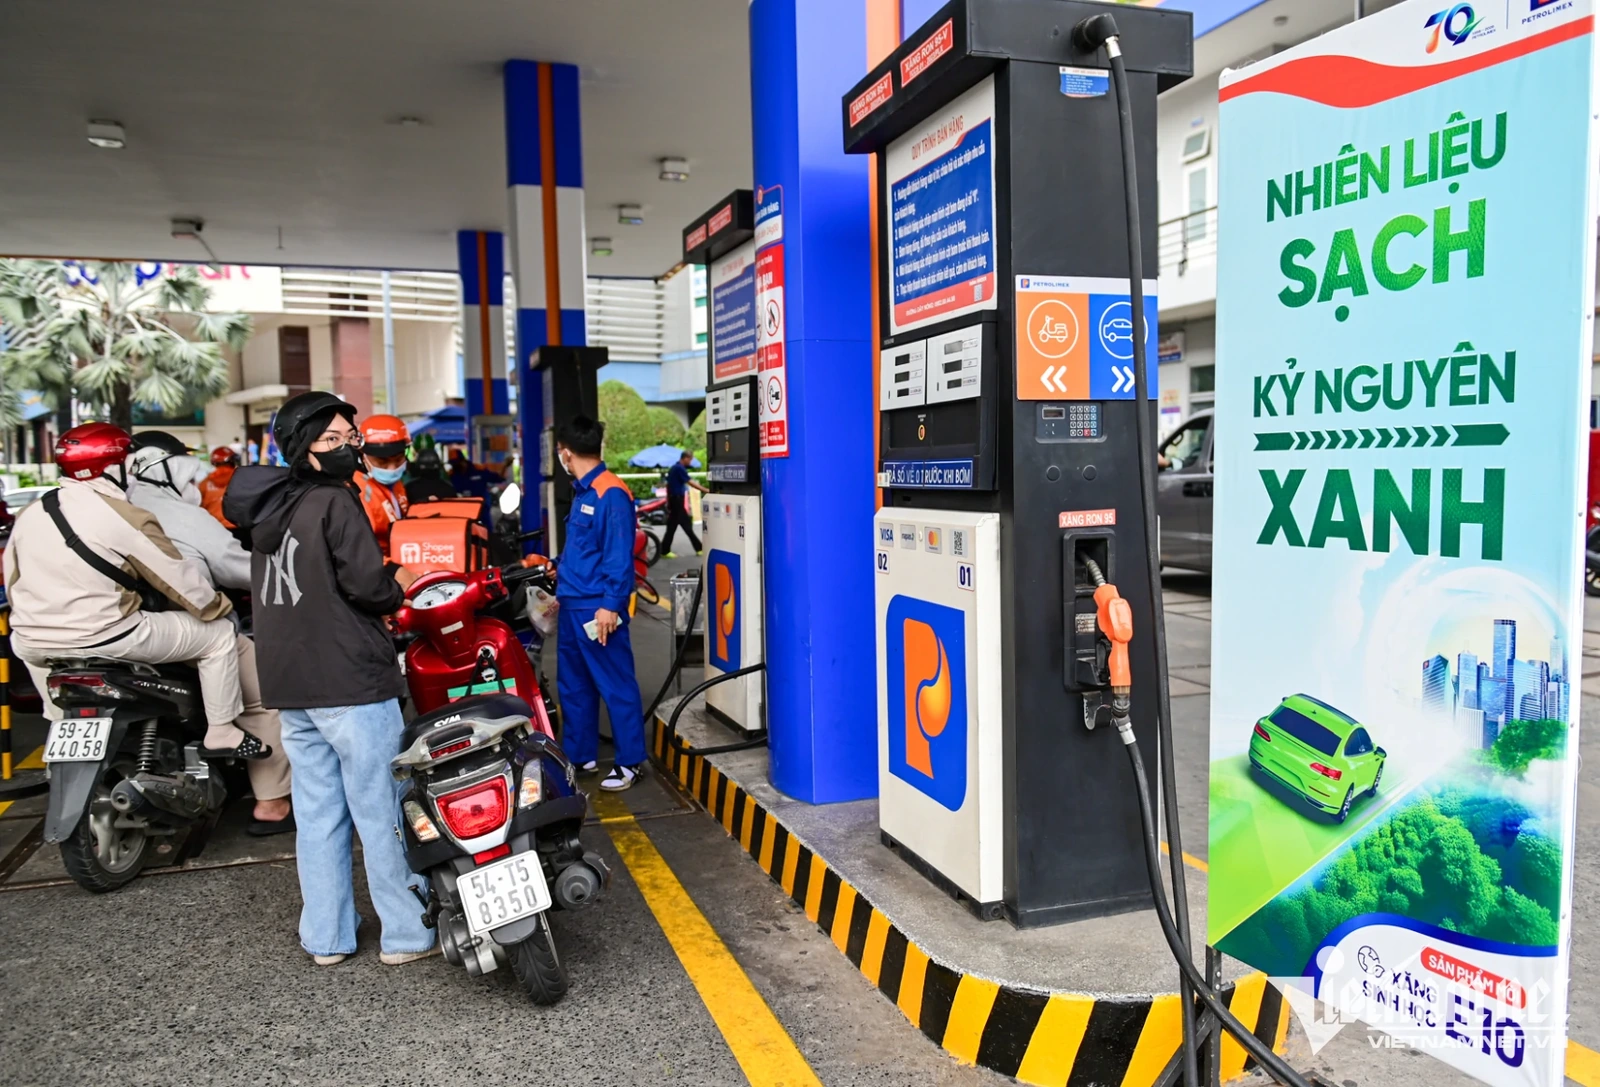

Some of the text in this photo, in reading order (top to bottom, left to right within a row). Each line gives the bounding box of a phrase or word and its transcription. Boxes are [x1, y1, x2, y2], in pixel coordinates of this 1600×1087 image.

[1521, 1, 1573, 25] PETROLIMEX
[1266, 109, 1507, 223] NHIÊN LIỆU
[1277, 197, 1487, 323] SẠCH
[1253, 340, 1517, 418] KỶ NGUYÊN
[897, 465, 906, 482] SỐ
[944, 469, 954, 483] KHI
[956, 467, 971, 484] BƠM
[1062, 512, 1114, 526] XĂNG RON 95
[1256, 467, 1506, 561] XANH
[422, 542, 454, 553] Shopee
[880, 528, 894, 541] VISA
[422, 552, 454, 564] Food
[878, 553, 887, 571] 02
[960, 565, 971, 586] 01
[58, 722, 100, 739] 59-Z1
[48, 740, 103, 758] 440.58
[470, 858, 530, 900] 54-T5
[478, 884, 538, 925] 8350
[1389, 967, 1438, 1004] XĂNG
[1428, 953, 1455, 975] SẢN
[1455, 963, 1494, 991] PHẨM
[1362, 979, 1437, 1030] SINH HỌC
[1446, 992, 1526, 1068] E10
